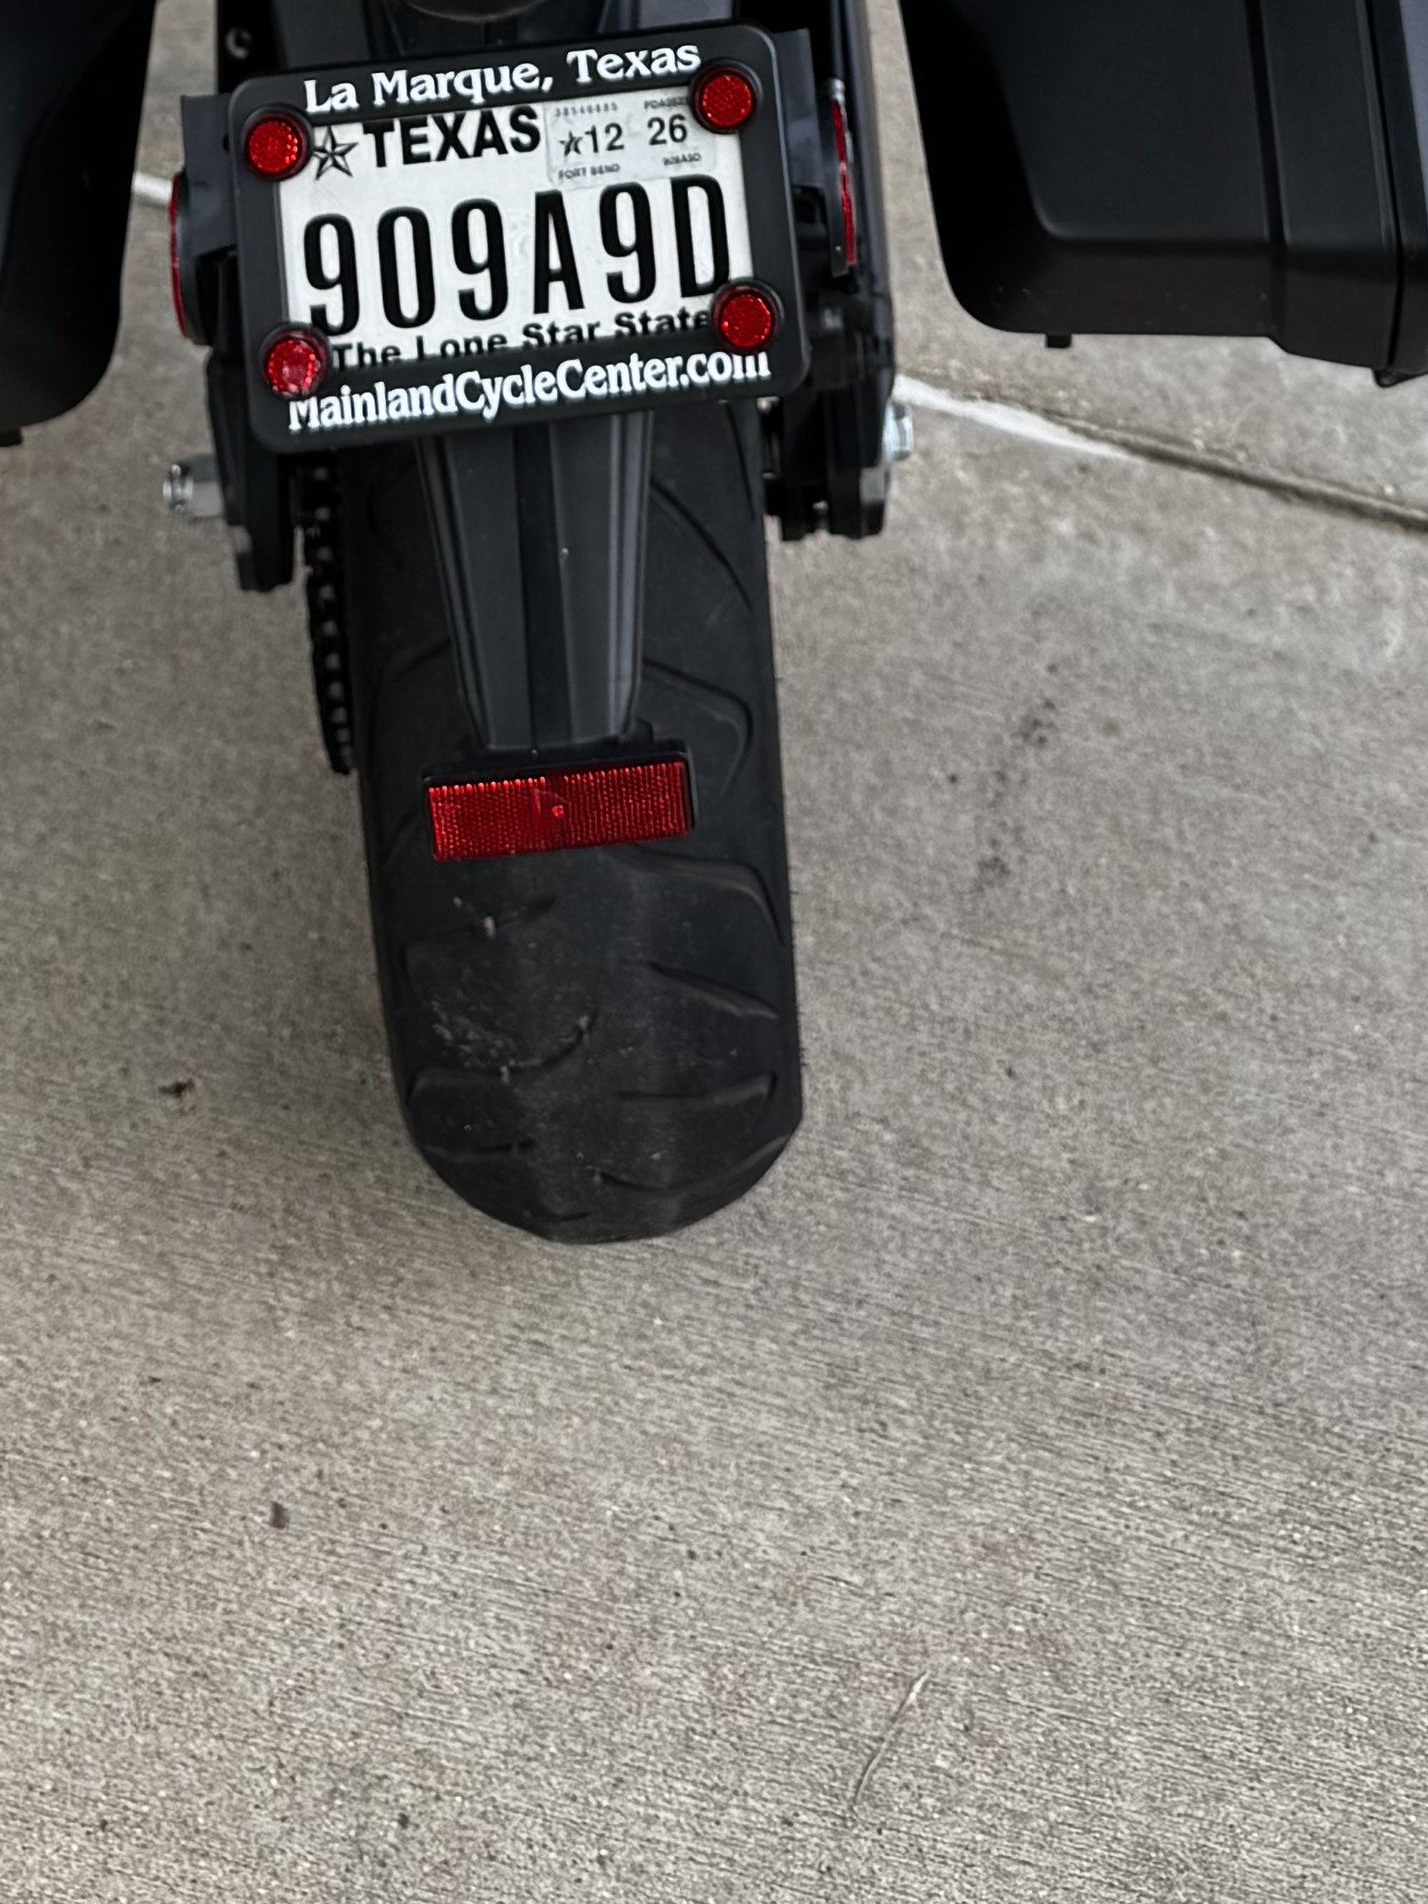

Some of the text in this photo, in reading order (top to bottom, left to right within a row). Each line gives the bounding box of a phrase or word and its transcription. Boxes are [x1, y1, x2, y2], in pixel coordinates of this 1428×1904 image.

[303, 44, 702, 115] La Marque, Texas
[362, 104, 542, 168] TEXAS
[584, 113, 688, 154] 12 26
[303, 174, 731, 337] 909A9D
[332, 341, 401, 371] The
[521, 320, 601, 349] Star
[614, 306, 712, 340] State
[288, 350, 772, 432] MainlandCycleCenter.com
